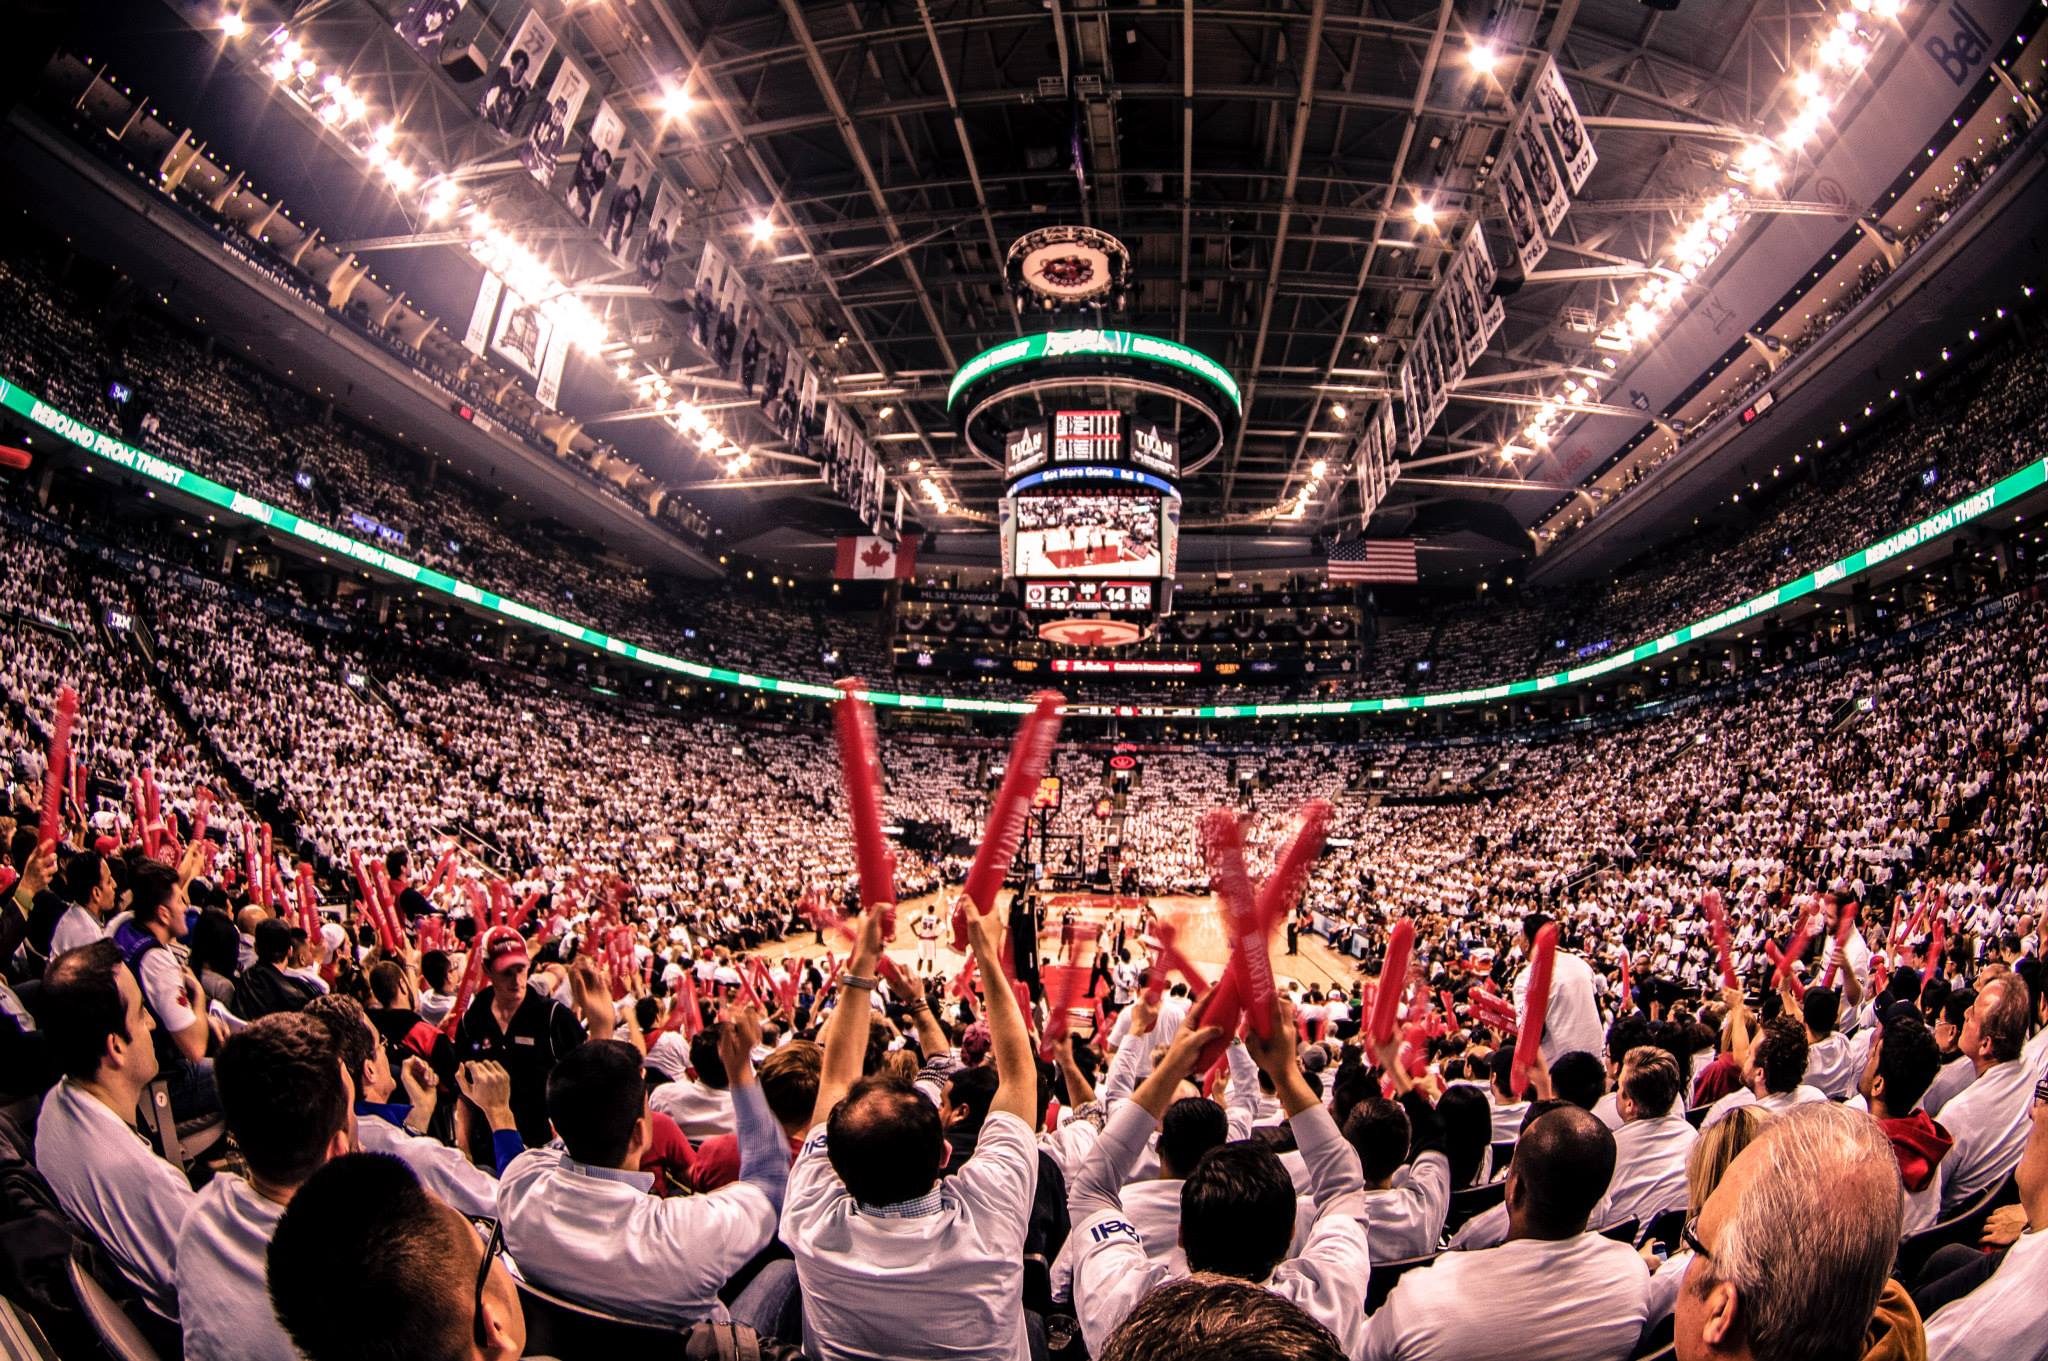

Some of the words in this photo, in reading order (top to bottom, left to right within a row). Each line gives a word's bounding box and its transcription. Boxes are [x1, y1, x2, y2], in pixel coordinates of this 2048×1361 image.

[522, 32, 543, 56] 27
[1924, 3, 1992, 87] Bell
[1572, 149, 1591, 185] 1967
[30, 400, 94, 448] REBOUND
[94, 433, 136, 468] FROM
[135, 452, 185, 486] THIRST
[1010, 431, 1043, 461] TITAN
[1135, 428, 1173, 460] TITAN
[1060, 467, 1084, 478] More
[1085, 467, 1114, 478] Game
[1865, 528, 1919, 567] REBOUND
[1919, 509, 1953, 542] FROM
[1953, 487, 1996, 524] THIRST
[1050, 588, 1070, 601] 21
[1105, 588, 1126, 601] 14
[2003, 596, 2019, 610] 120
[804, 1134, 828, 1155] ell
